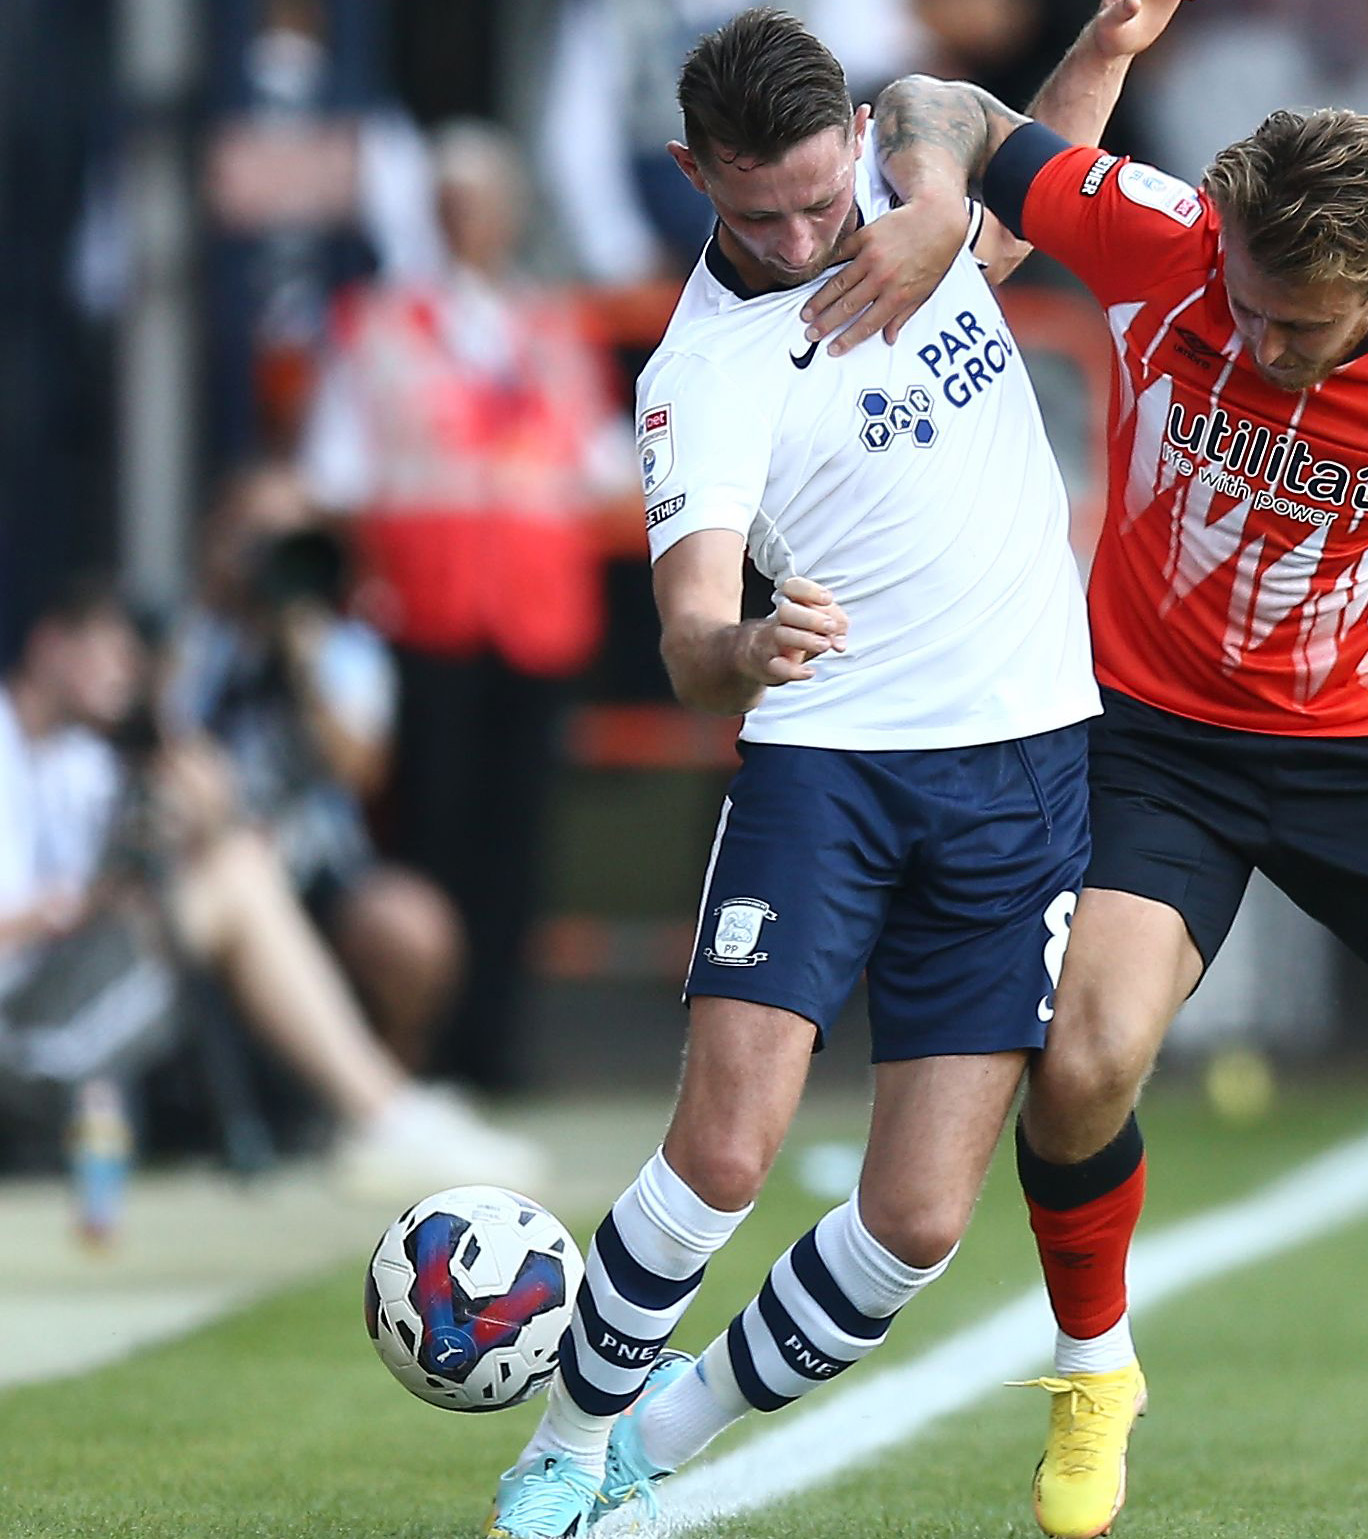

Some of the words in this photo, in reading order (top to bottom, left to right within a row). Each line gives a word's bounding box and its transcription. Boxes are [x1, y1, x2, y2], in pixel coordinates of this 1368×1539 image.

[917, 311, 986, 378] PAR
[943, 321, 1012, 408] GROU
[868, 389, 930, 446] PAR
[1162, 441, 1192, 476] life
[1199, 465, 1250, 499] with
[1254, 489, 1339, 527] power
[1166, 403, 1350, 506] utilita
[646, 496, 684, 528] ETHER
[600, 1333, 660, 1360] PNE
[784, 1335, 839, 1376] PNE
